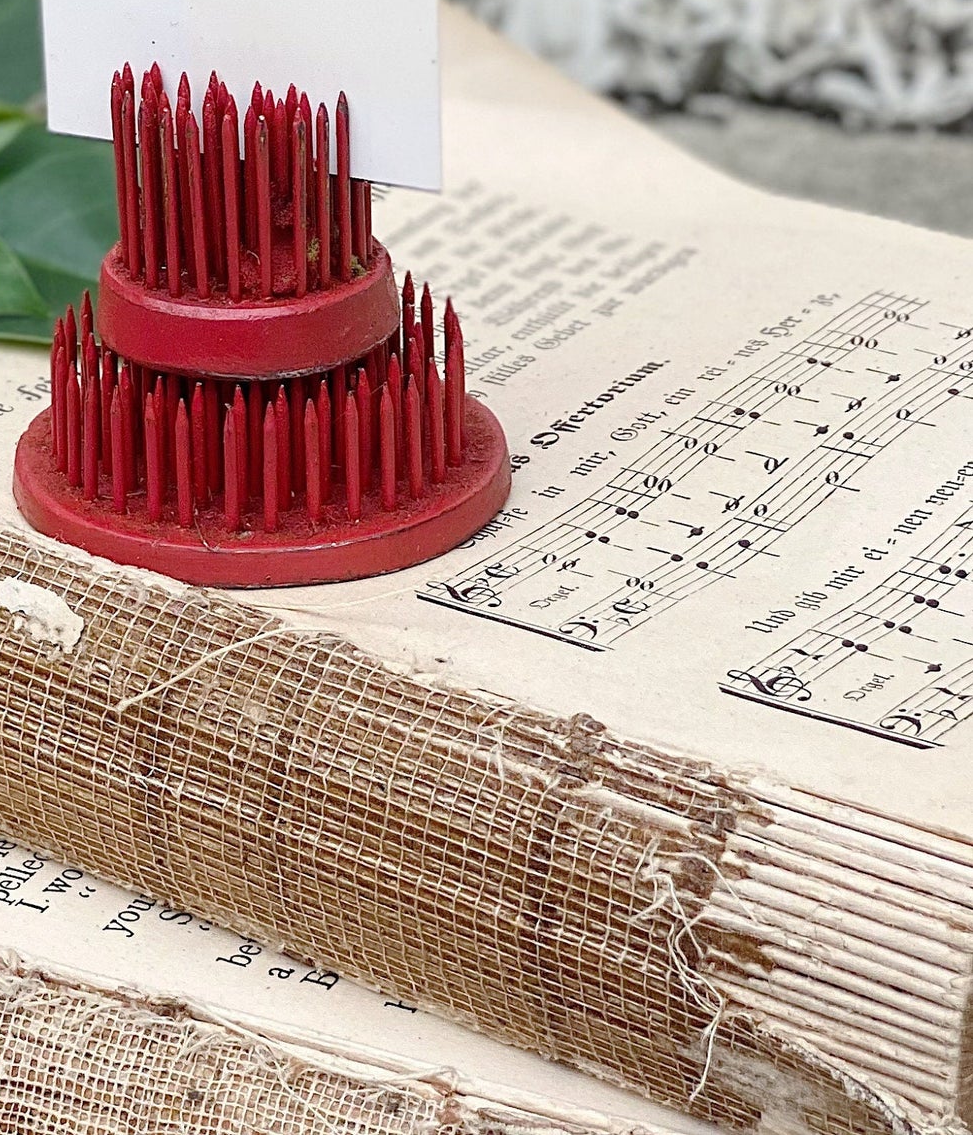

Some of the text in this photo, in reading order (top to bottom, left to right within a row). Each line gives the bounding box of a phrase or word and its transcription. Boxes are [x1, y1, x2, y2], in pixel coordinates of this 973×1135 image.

[664, 388, 696, 406] ein
[745, 609, 795, 633] Und
[795, 591, 828, 610] gib
[825, 566, 865, 590] mir
